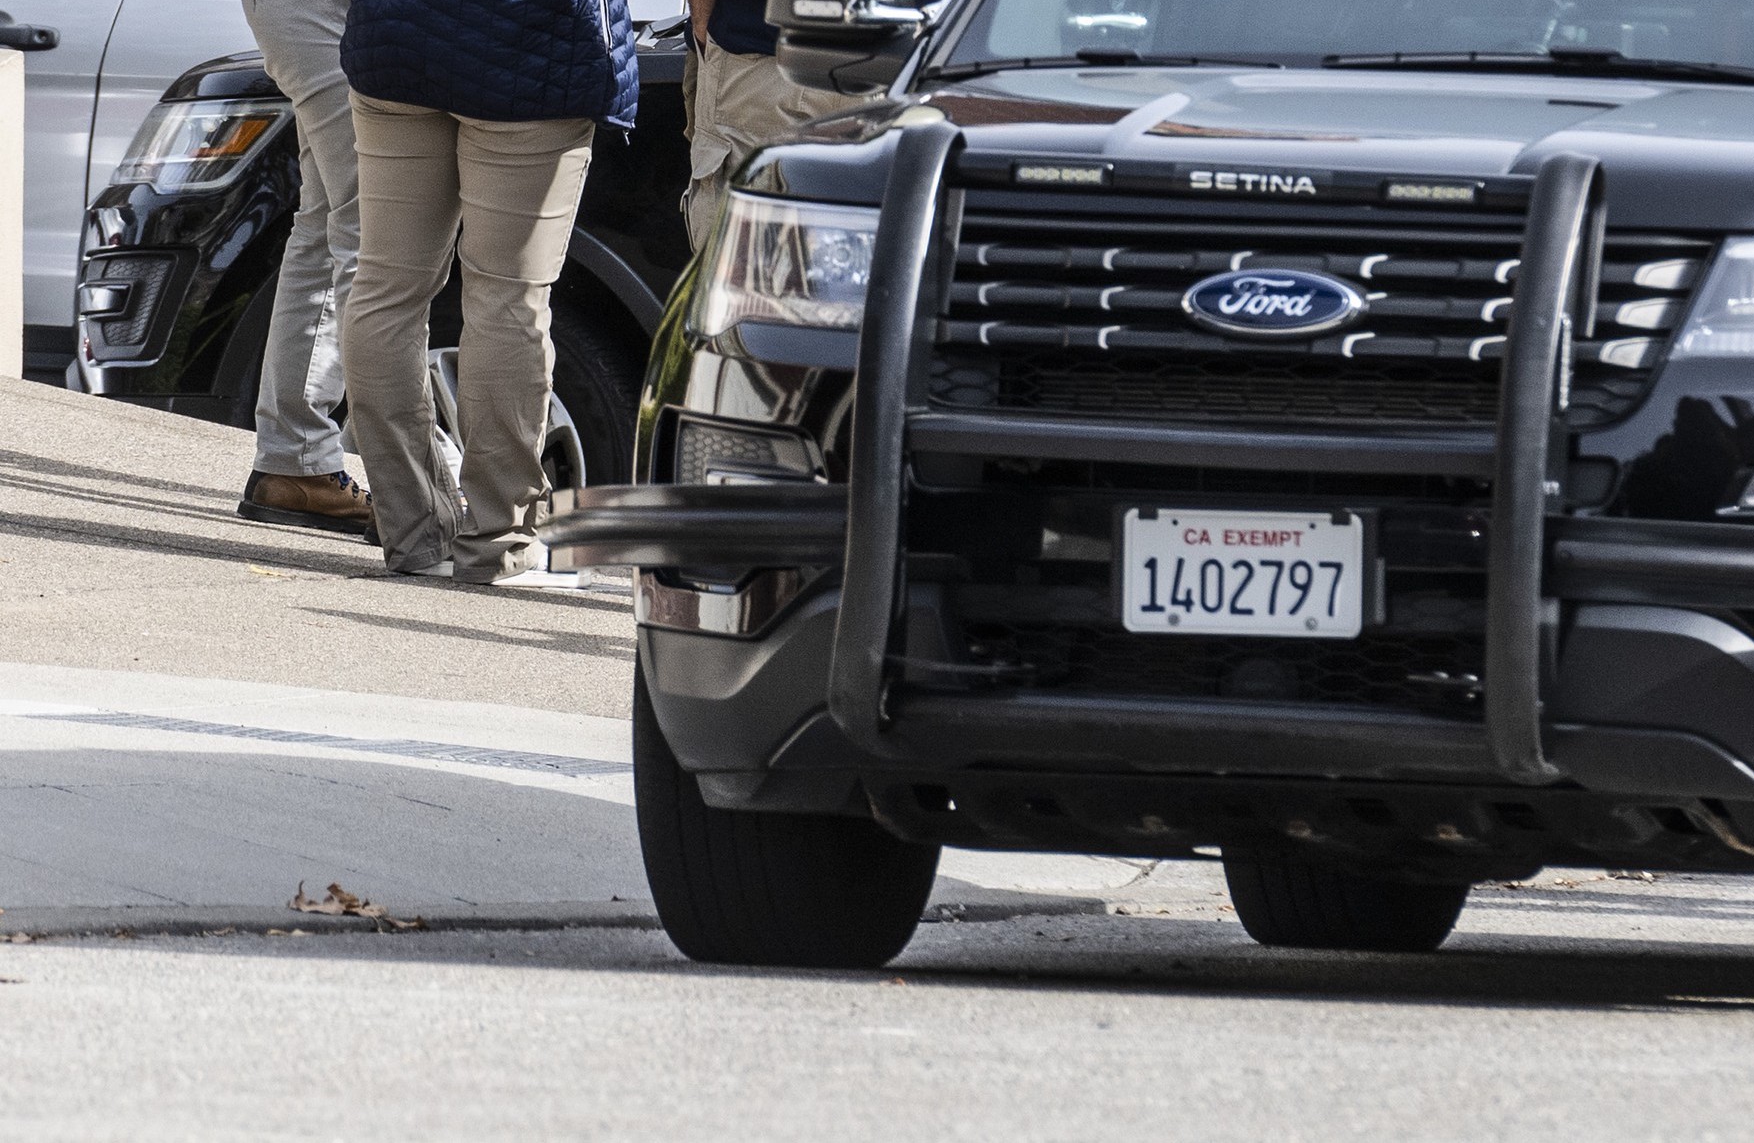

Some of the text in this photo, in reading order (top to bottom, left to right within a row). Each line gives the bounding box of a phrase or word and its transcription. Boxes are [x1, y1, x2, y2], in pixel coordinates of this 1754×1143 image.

[1190, 171, 1316, 195] SETINA
[1218, 277, 1315, 317] Ford
[1183, 528, 1304, 548] CA EXEMPT
[1140, 557, 1344, 618] 1402797
